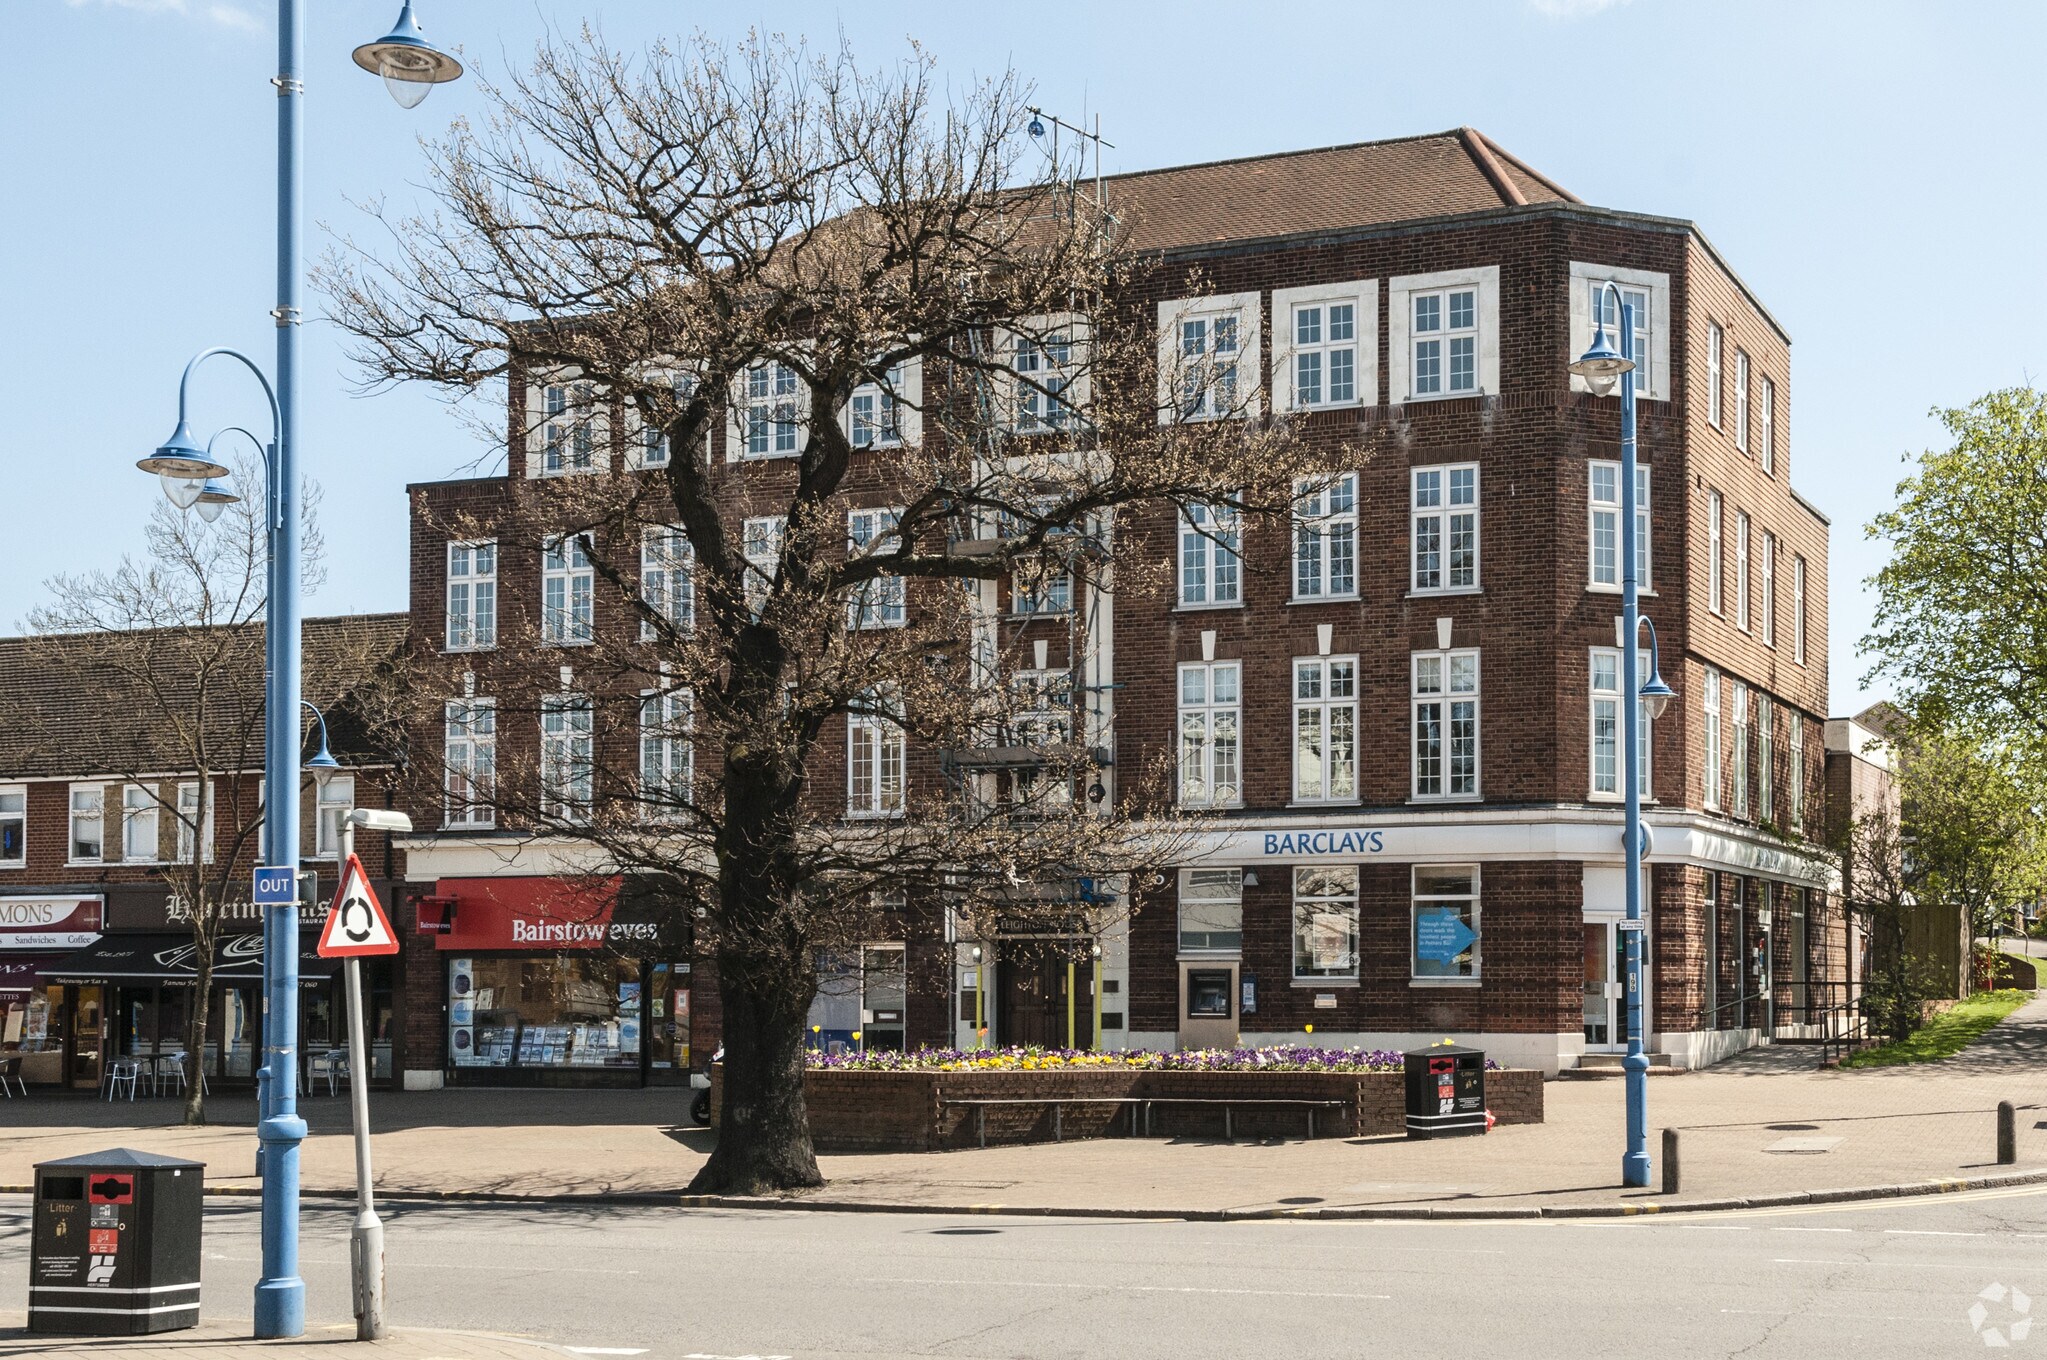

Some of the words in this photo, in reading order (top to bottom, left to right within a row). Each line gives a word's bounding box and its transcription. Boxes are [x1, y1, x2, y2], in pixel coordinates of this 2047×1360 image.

[1264, 831, 1384, 855] BARCLAYS
[259, 878, 290, 893] OUT
[512, 919, 603, 942] Bairstow
[609, 921, 657, 941] eves
[15, 936, 57, 945] Sandwiches
[67, 934, 92, 944] Coffee
[49, 1203, 75, 1213] Litter
